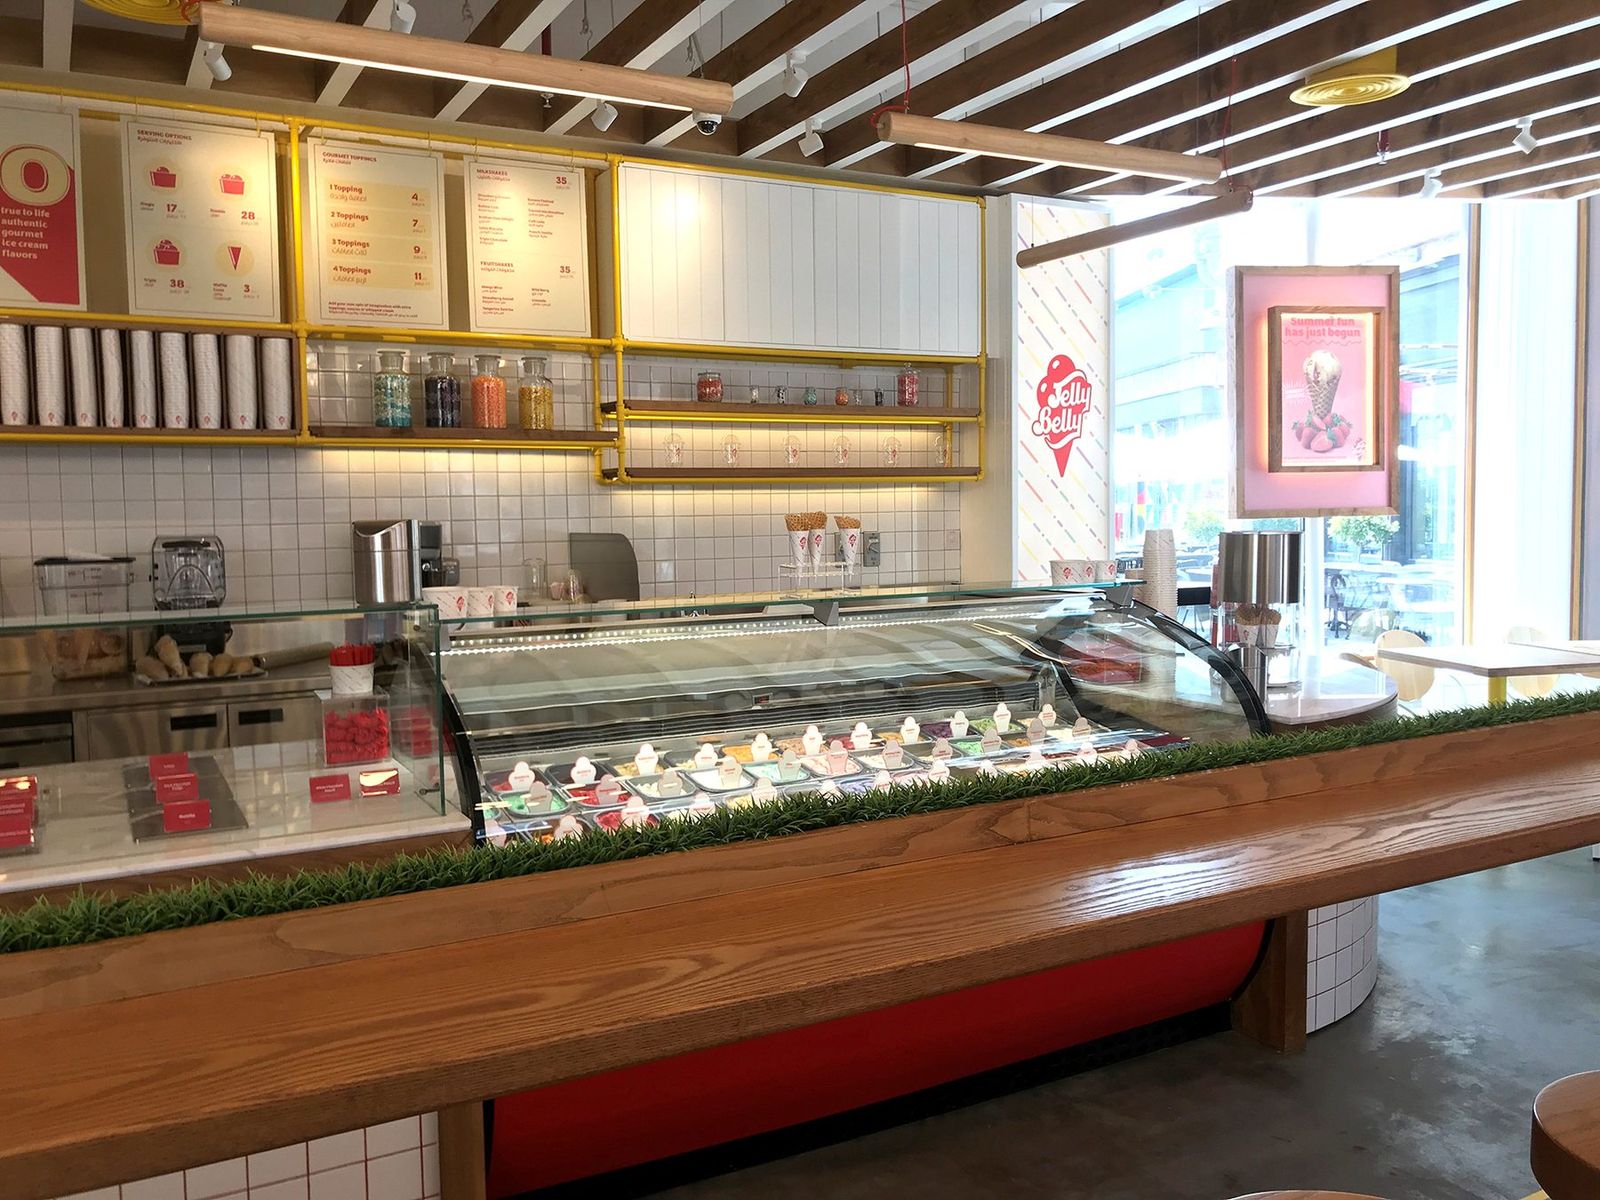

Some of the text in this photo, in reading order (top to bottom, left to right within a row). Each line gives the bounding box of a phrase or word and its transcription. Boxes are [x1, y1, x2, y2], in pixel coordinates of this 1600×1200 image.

[136, 130, 164, 138] SERVING
[322, 152, 349, 160] GOURMET
[350, 154, 377, 162] TOPPINGS
[476, 168, 508, 176] MILKSHAKES
[556, 176, 567, 184] 35
[334, 184, 363, 194] Topping
[412, 193, 418, 201] 4
[1, 207, 50, 218] true to life
[166, 203, 177, 213] 17
[241, 211, 255, 220] 28
[337, 212, 369, 222] Toppings
[1, 218, 48, 228] authentic
[413, 219, 418, 227] 7
[1, 229, 43, 239] gourmet
[18, 241, 48, 250] cream
[337, 239, 370, 248] Toppings
[2, 249, 38, 259] flavors
[414, 246, 420, 254] 9
[339, 266, 372, 275] Toppings
[560, 266, 571, 274] 35
[415, 272, 422, 280] 11
[170, 279, 185, 288] 38
[244, 284, 250, 293] 3
[1291, 317, 1355, 326] Summer fun
[1285, 327, 1361, 339] has just begun
[1047, 378, 1091, 412] Jelly
[1032, 406, 1083, 439] Belly
